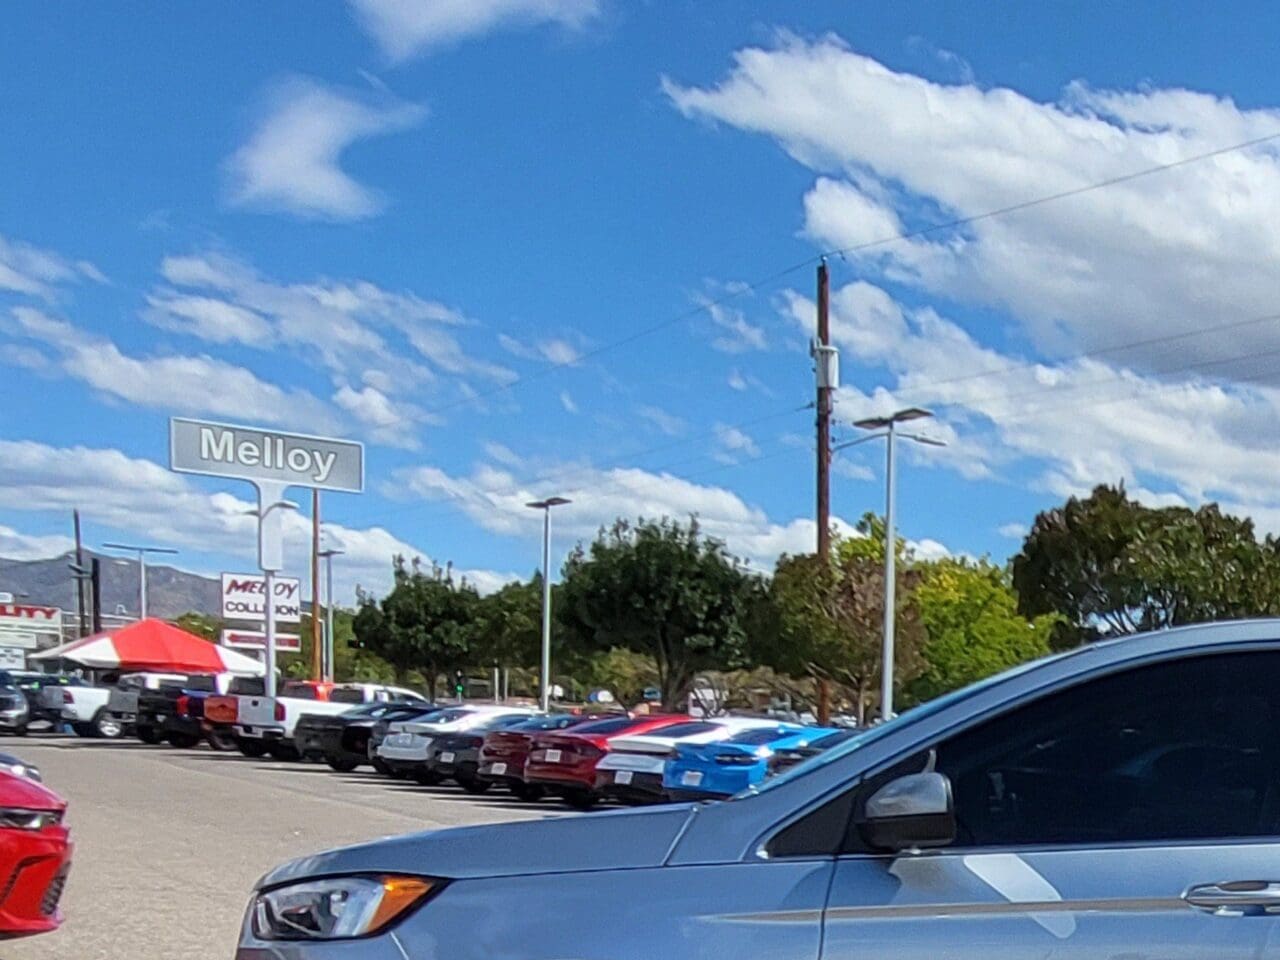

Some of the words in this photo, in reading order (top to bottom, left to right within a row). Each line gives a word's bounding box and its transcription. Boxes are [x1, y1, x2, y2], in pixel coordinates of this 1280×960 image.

[200, 427, 337, 482] Melloy
[225, 579, 298, 599] MELOY
[225, 601, 299, 616] COLLIION
